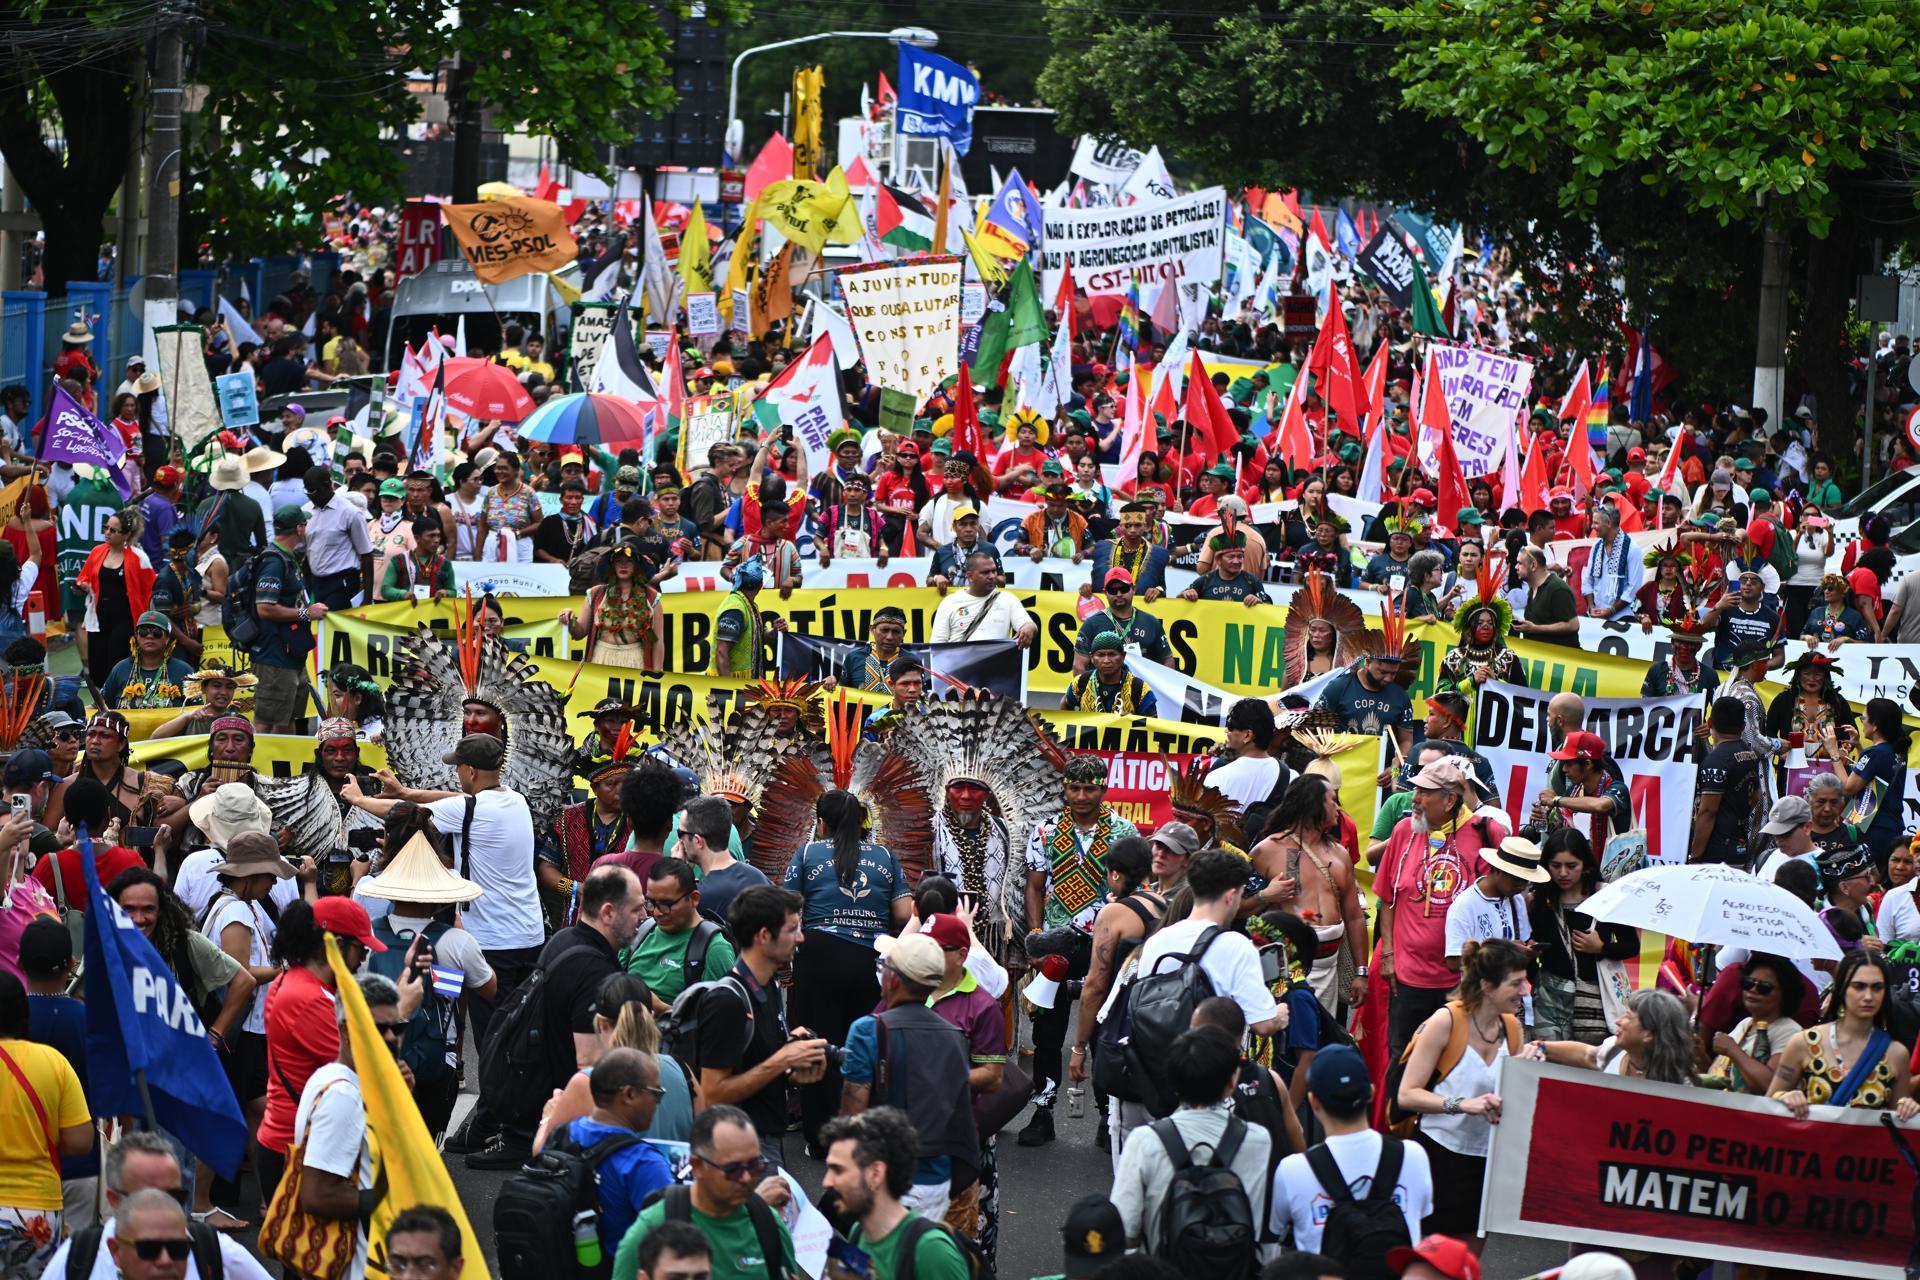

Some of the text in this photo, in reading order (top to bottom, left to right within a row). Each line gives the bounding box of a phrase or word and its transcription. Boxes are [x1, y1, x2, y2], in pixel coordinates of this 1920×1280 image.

[1151, 215, 1163, 231] DE
[793, 413, 827, 454] LIVRE
[1212, 586, 1243, 596] COP 30
[1354, 699, 1391, 713] COP 30
[807, 863, 825, 882] COP
[842, 909, 877, 918] FUTURO
[1608, 1119, 1900, 1186] NÃO PERMITA QUE
[1602, 1165, 1890, 1237] MATEM O RIO!
